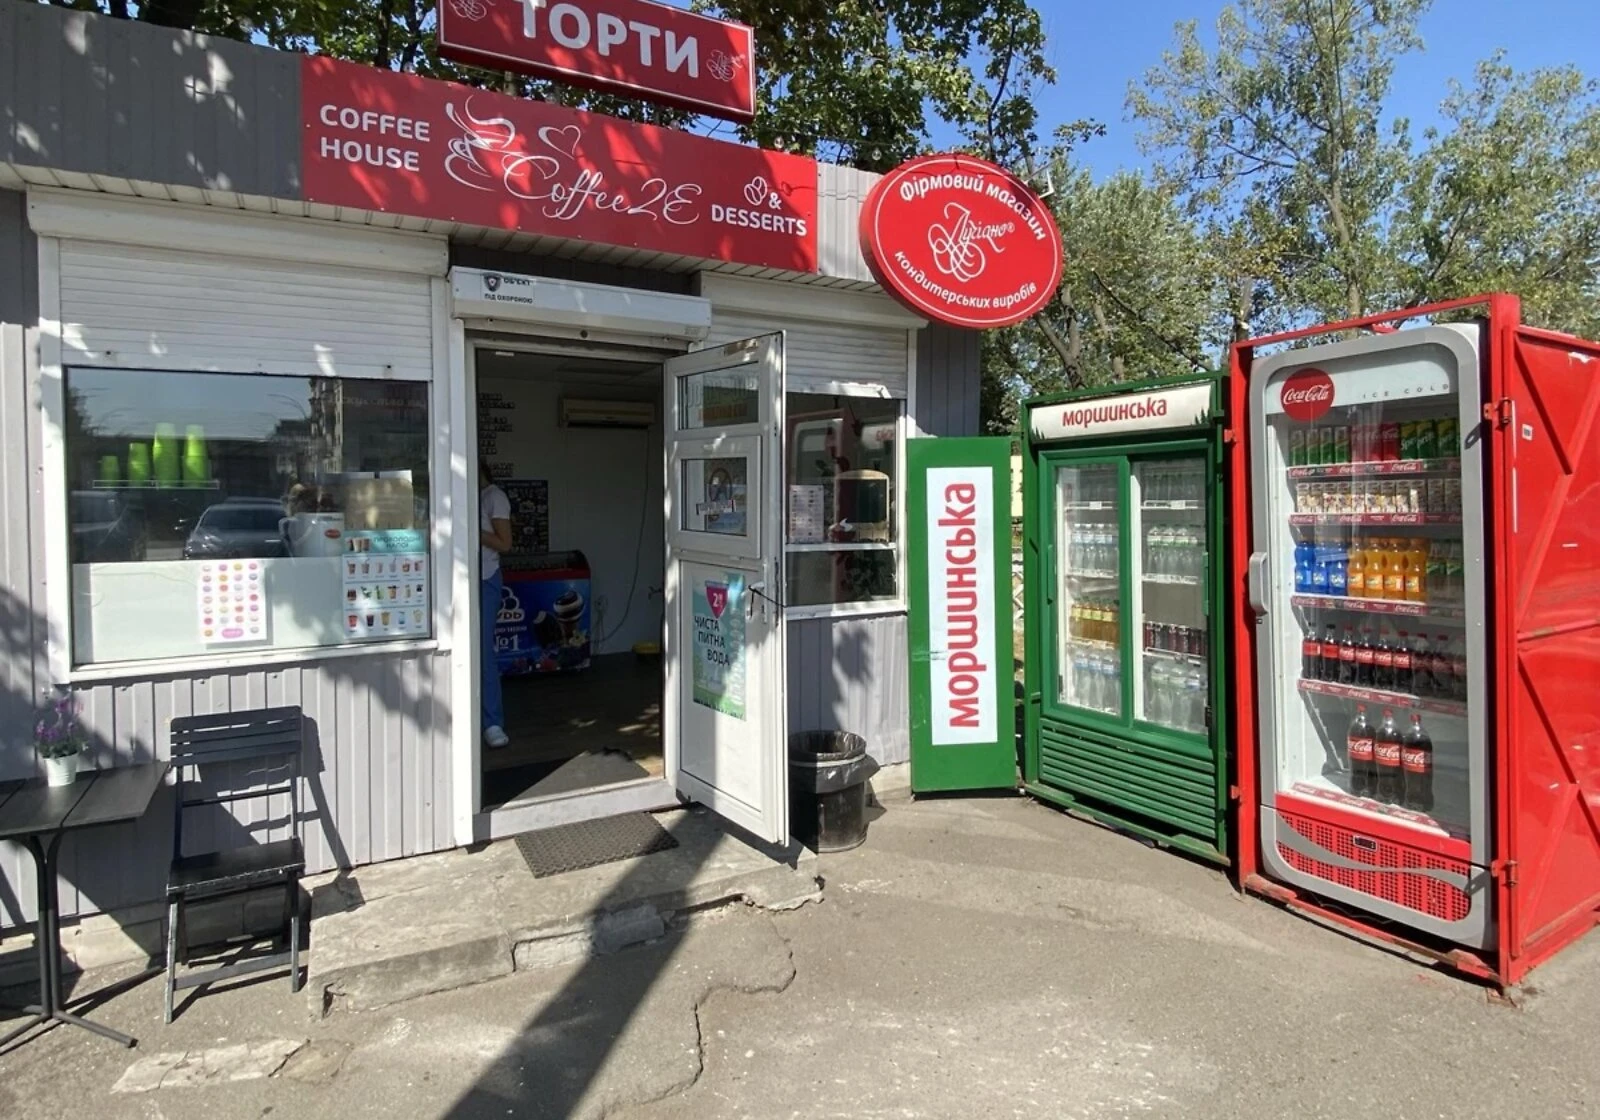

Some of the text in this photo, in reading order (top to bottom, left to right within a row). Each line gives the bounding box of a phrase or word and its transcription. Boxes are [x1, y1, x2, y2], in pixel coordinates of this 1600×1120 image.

[512, 0, 699, 78] ТОРТИ
[320, 104, 430, 142] COFFEE
[320, 136, 420, 172] HOUSE
[711, 204, 808, 237] DESSERTS
[900, 174, 1047, 241] Фірмовий магазин
[894, 250, 1037, 310] кондитерських виробів
[1362, 382, 1450, 399] ICE COLD
[1062, 397, 1168, 428] моршинська
[937, 482, 987, 729] моршинська
[694, 615, 720, 632] ЧИСТА
[698, 631, 726, 649] ПИТНА
[707, 649, 730, 666] ВОДА
